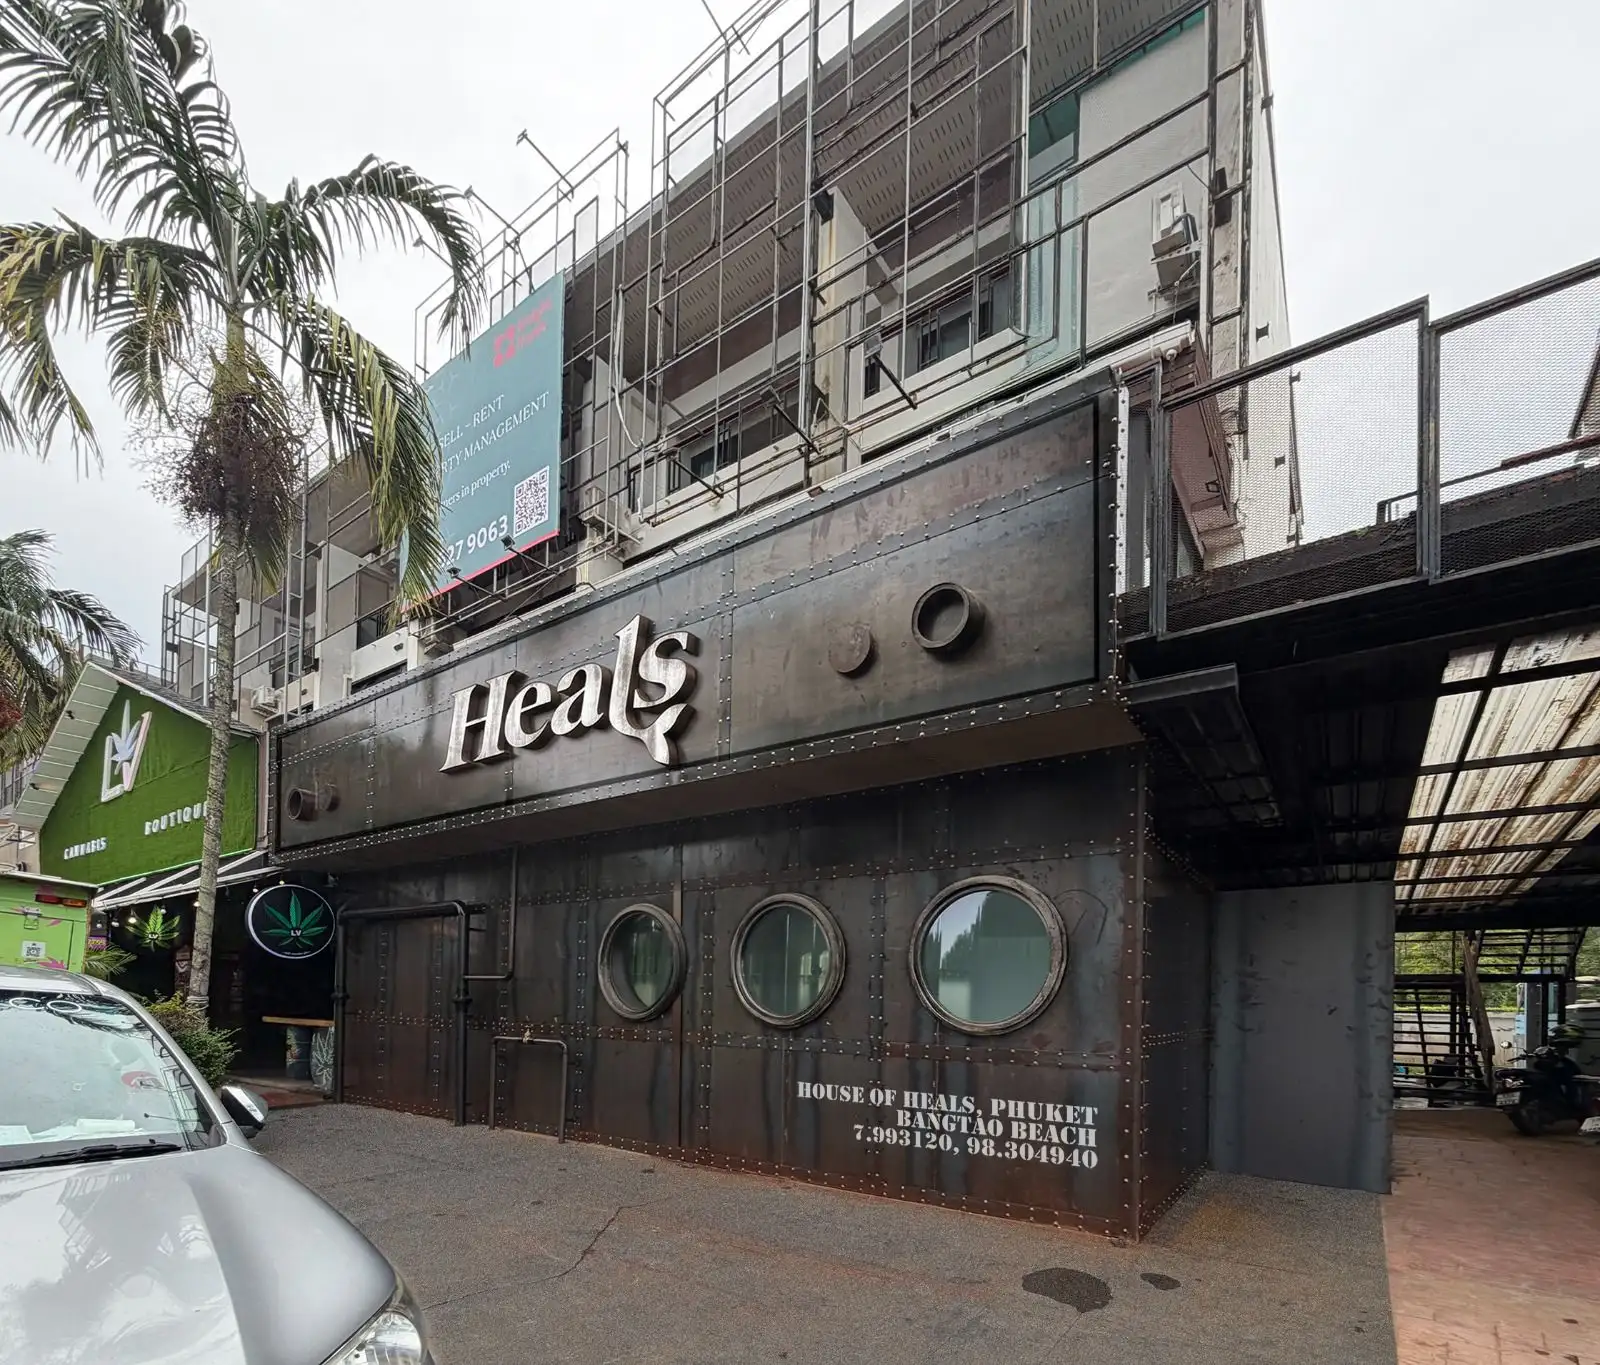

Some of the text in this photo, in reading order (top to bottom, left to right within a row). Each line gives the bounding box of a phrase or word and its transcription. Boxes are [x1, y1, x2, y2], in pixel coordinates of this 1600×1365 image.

[441, 391, 549, 473] RTY MANAGEMENT
[472, 394, 505, 428] RENT
[467, 515, 508, 554] 9063
[439, 613, 698, 772] Heals
[63, 836, 108, 860] CANNABIS
[797, 1081, 1099, 1126] HOUSE OF HEALS, PHUKET
[853, 1124, 1099, 1170] 7.993120, 98.304940
[896, 1109, 1097, 1148] BANGTAO BEACH
